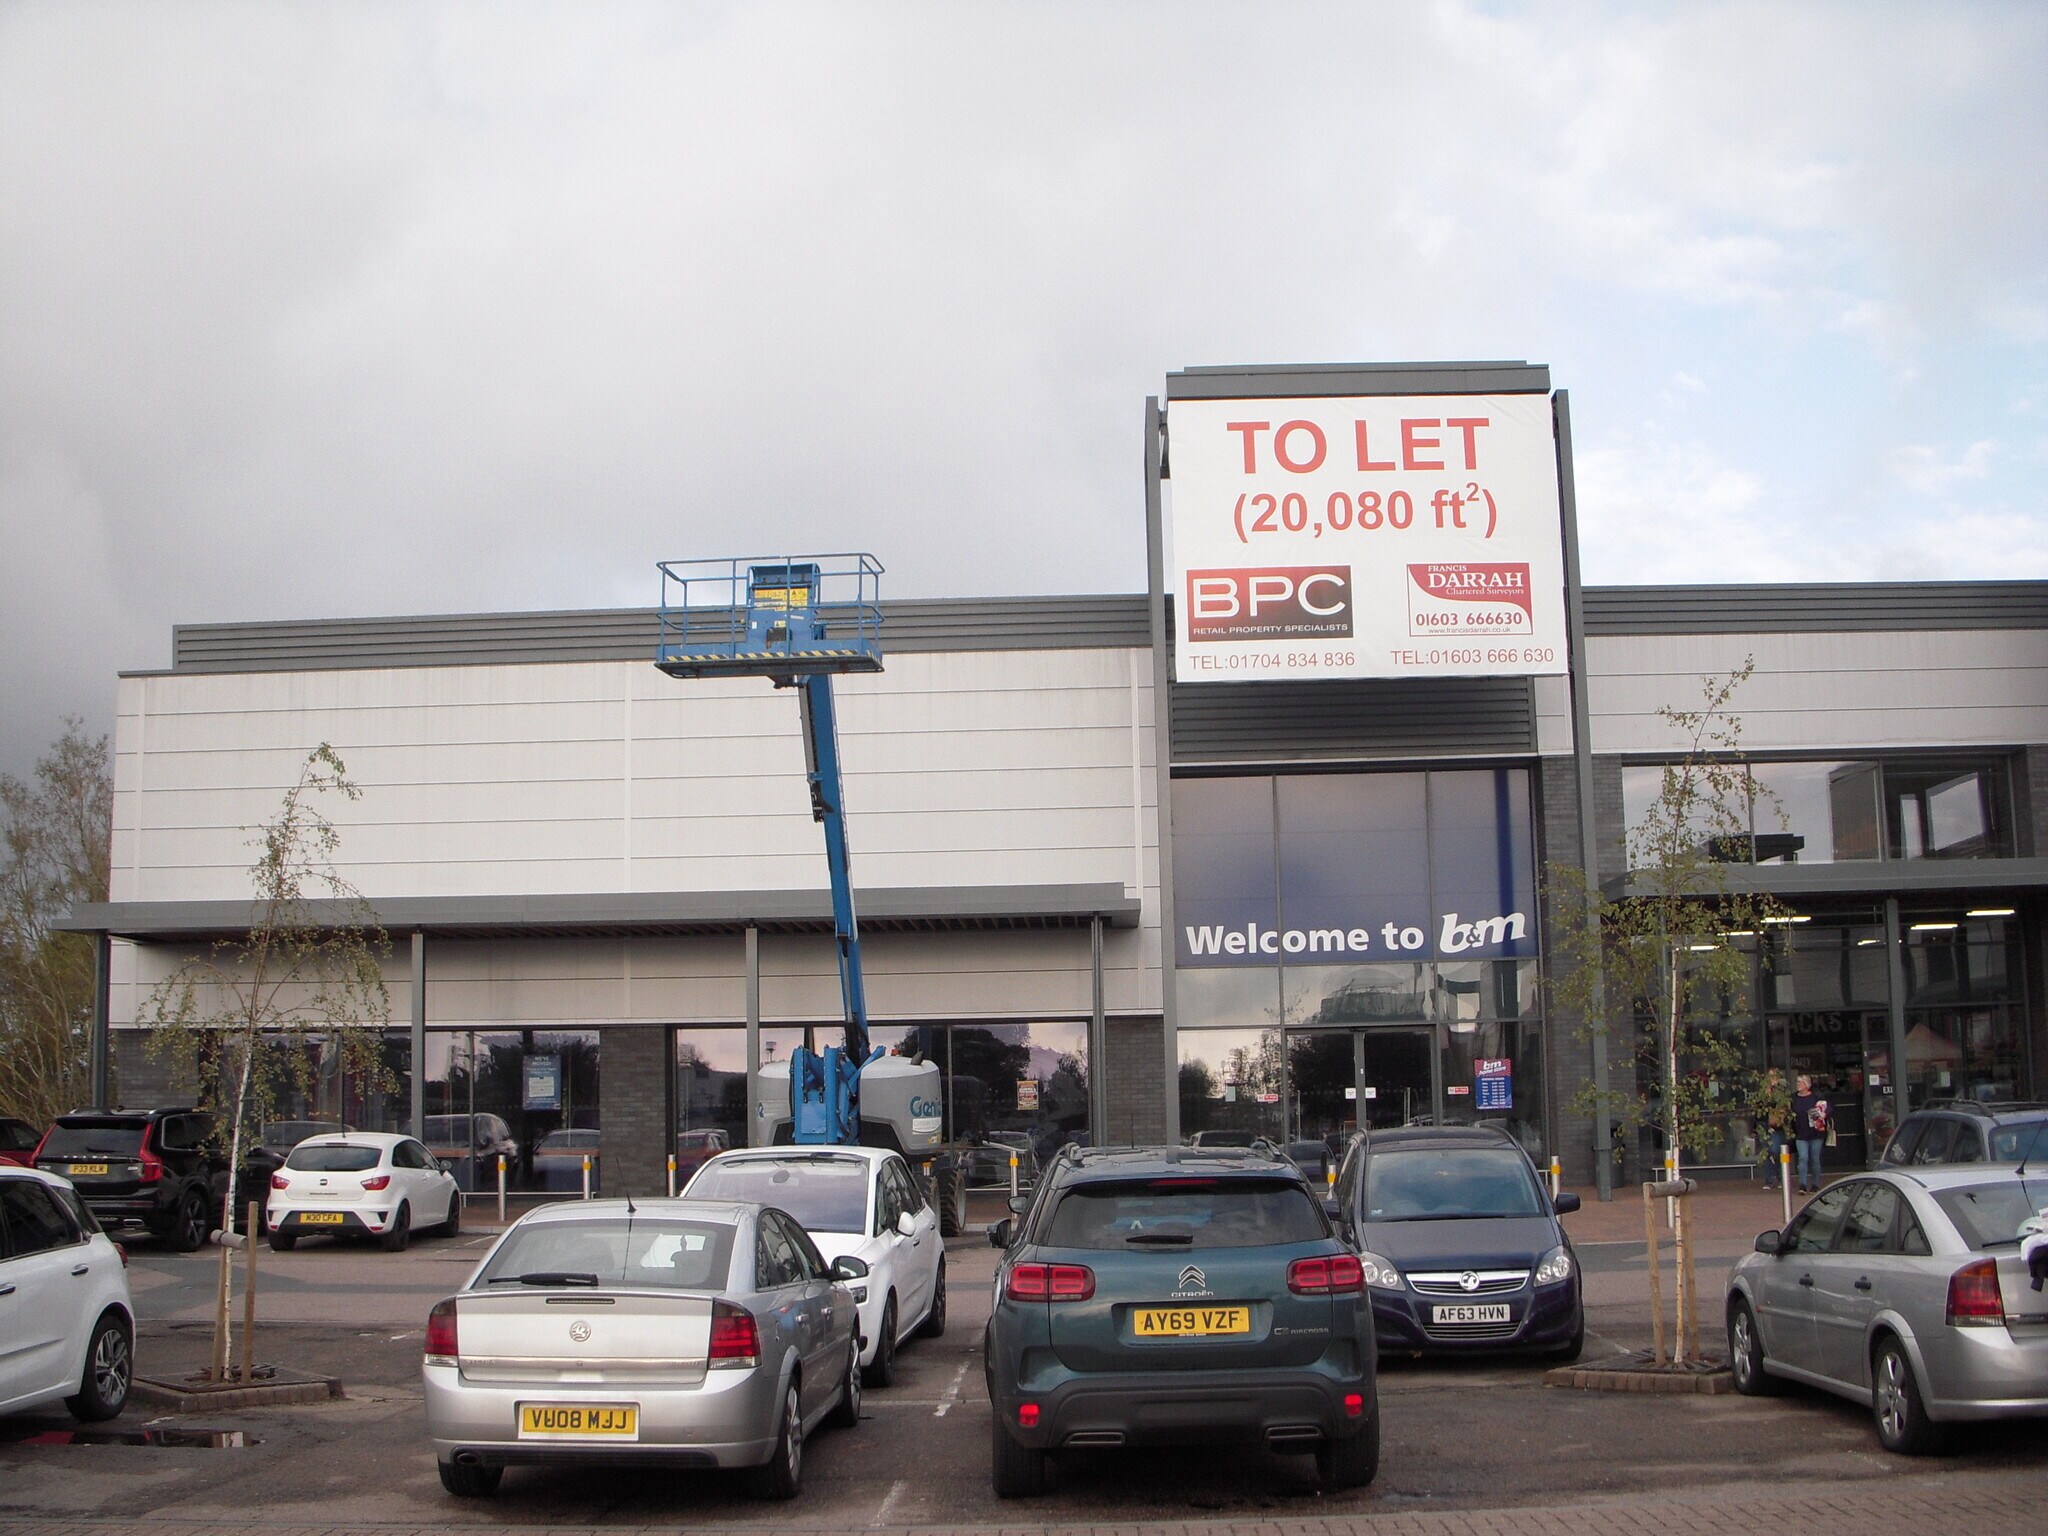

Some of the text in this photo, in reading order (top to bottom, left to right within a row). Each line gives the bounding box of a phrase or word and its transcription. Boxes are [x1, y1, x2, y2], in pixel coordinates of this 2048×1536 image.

[1226, 417, 1490, 475] TO LET
[1233, 489, 1414, 544] (20,080
[1427, 564, 1468, 573] FRANCIS
[1428, 572, 1524, 589] DARRAH
[1192, 573, 1346, 619] BPC
[1445, 587, 1525, 597] Chartered Surveyors
[1415, 612, 1523, 626] 01603 666630
[1193, 623, 1349, 635] RETAIL PROPERTY SPECIALISTS
[1428, 626, 1512, 635] www.francisdarrah.co.uk
[1189, 651, 1355, 670] TEL:01704 834 836
[1390, 648, 1554, 665] TEL:01603 666 630
[1185, 911, 1527, 955] Welcome to b&m
[1143, 1311, 1240, 1331] AY69 VZF
[1439, 1306, 1505, 1321] AF63 HVN
[532, 1409, 627, 1429] VU08 MJJ
